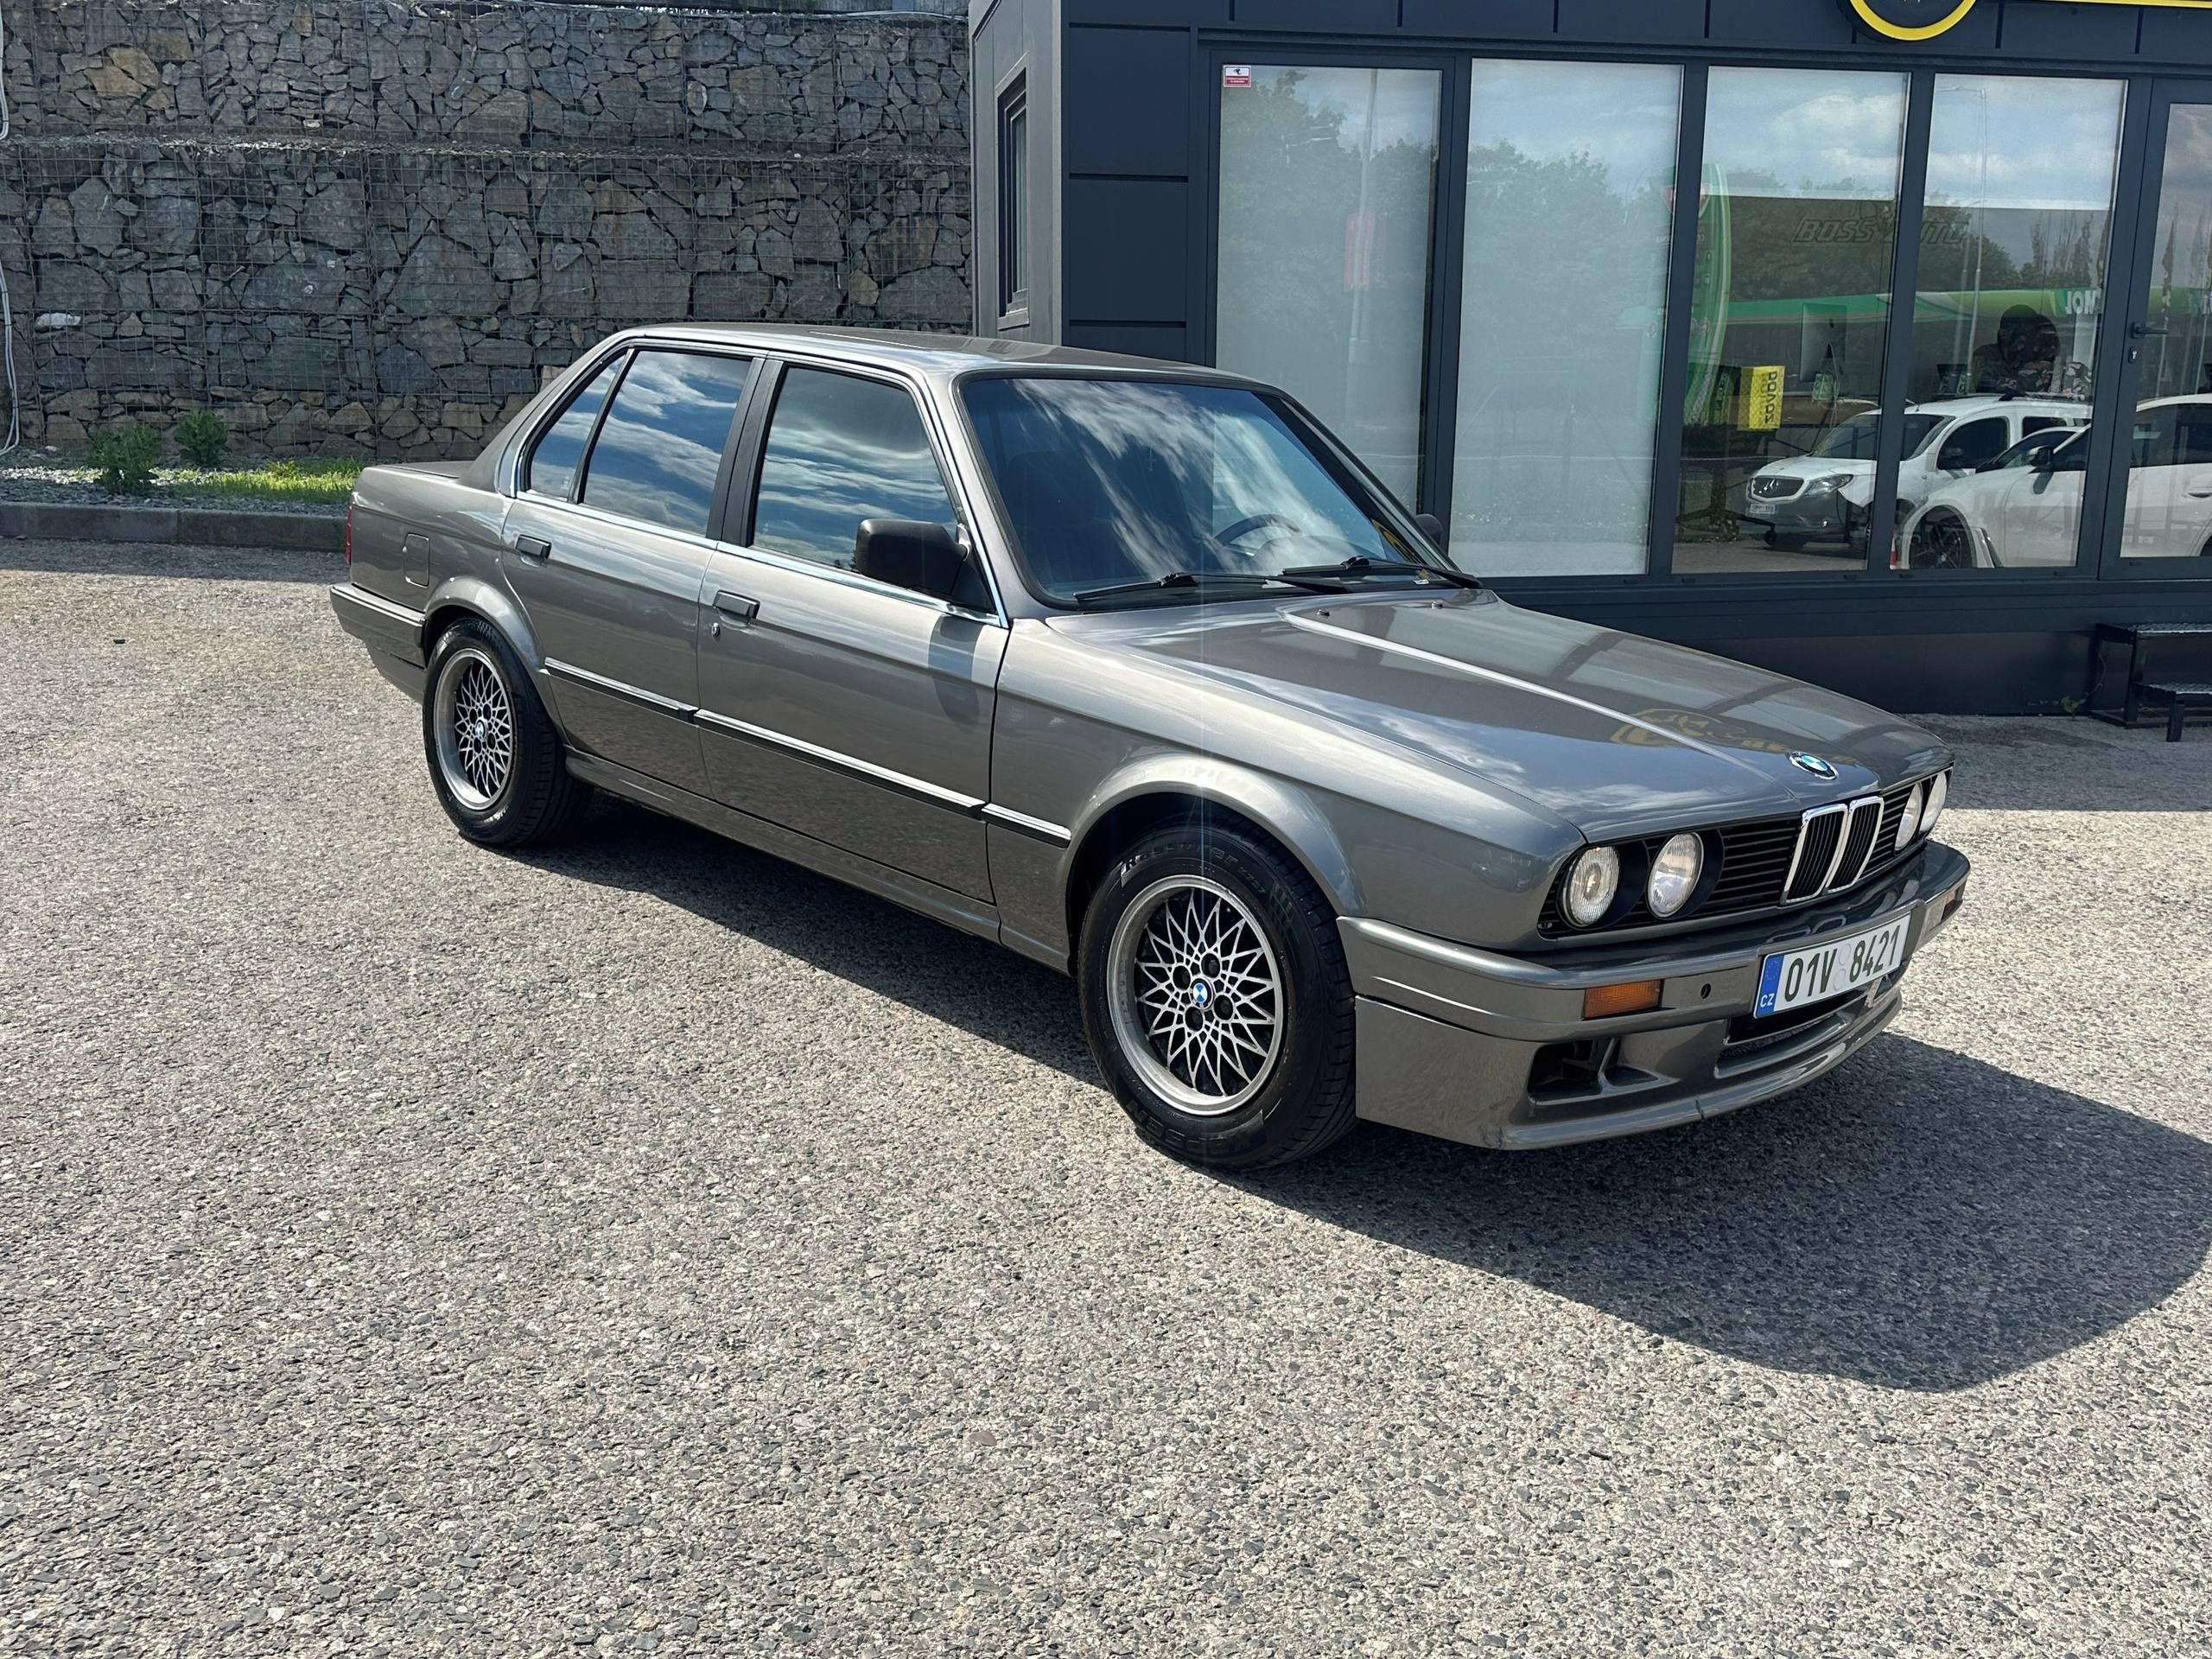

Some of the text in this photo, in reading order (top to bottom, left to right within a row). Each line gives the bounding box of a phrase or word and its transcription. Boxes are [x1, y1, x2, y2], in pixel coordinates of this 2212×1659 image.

[1791, 219, 1876, 244] BOSS
[1784, 925, 1901, 1002] 01V 8421
[1760, 993, 1775, 1008] CZ
